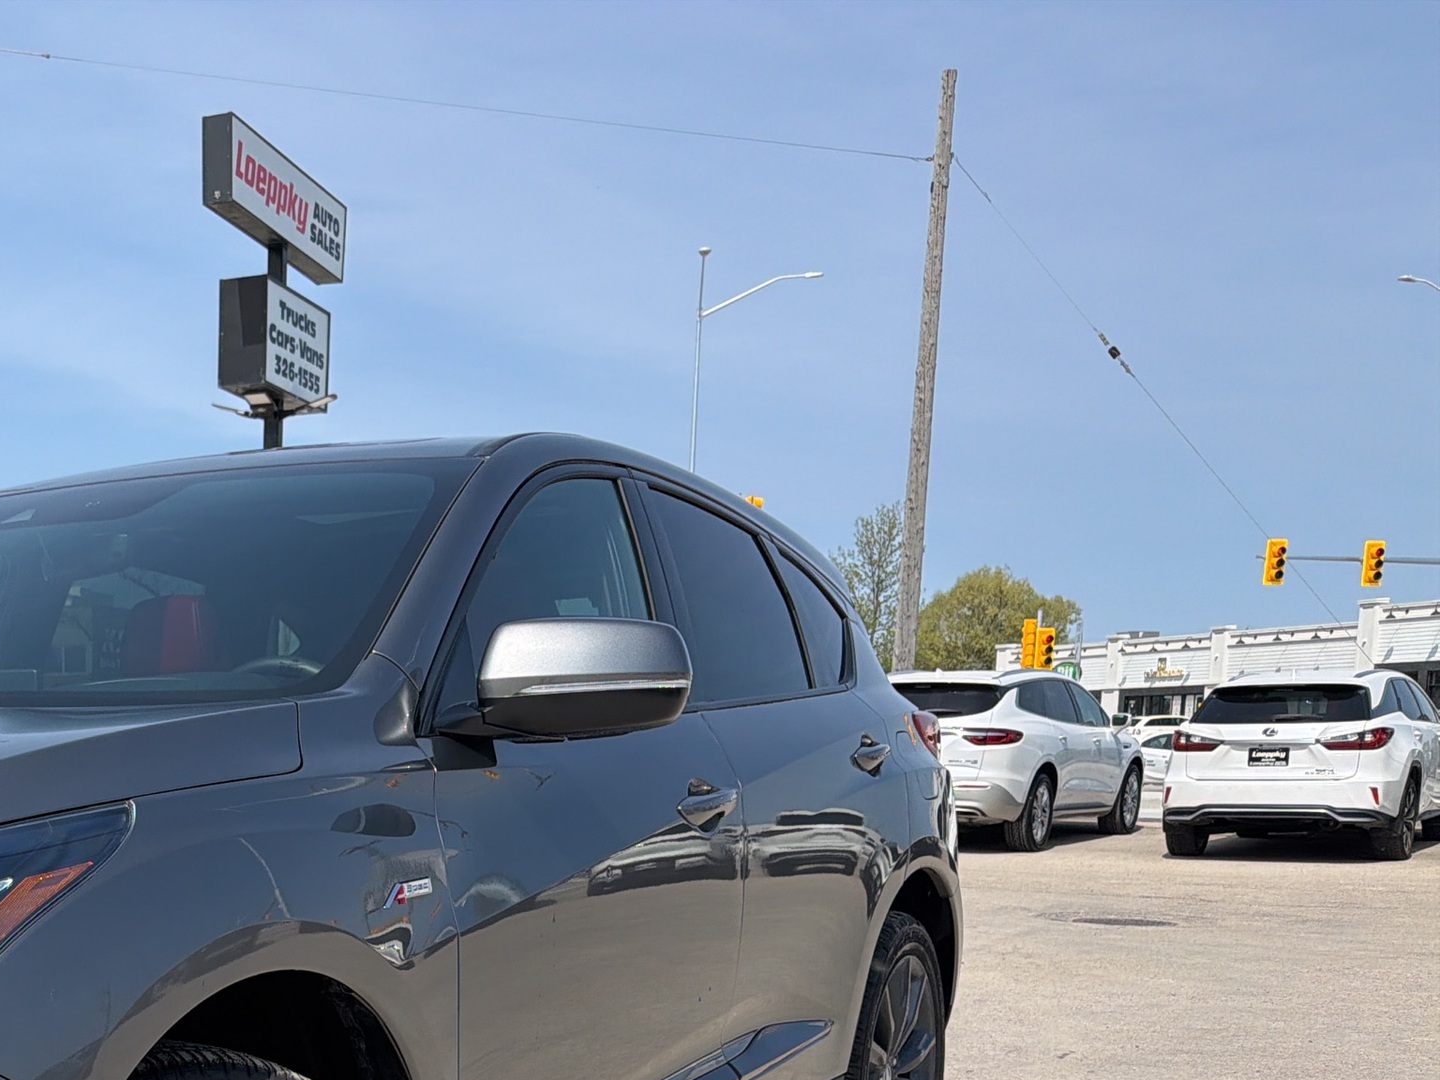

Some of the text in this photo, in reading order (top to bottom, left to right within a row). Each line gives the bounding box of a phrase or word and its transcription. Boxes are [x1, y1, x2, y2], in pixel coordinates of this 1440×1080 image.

[235, 139, 309, 235] Loeppky
[312, 201, 340, 238] AUTO
[309, 223, 341, 262] SALES
[279, 299, 317, 338] Trucks
[274, 354, 320, 395] 326-1555
